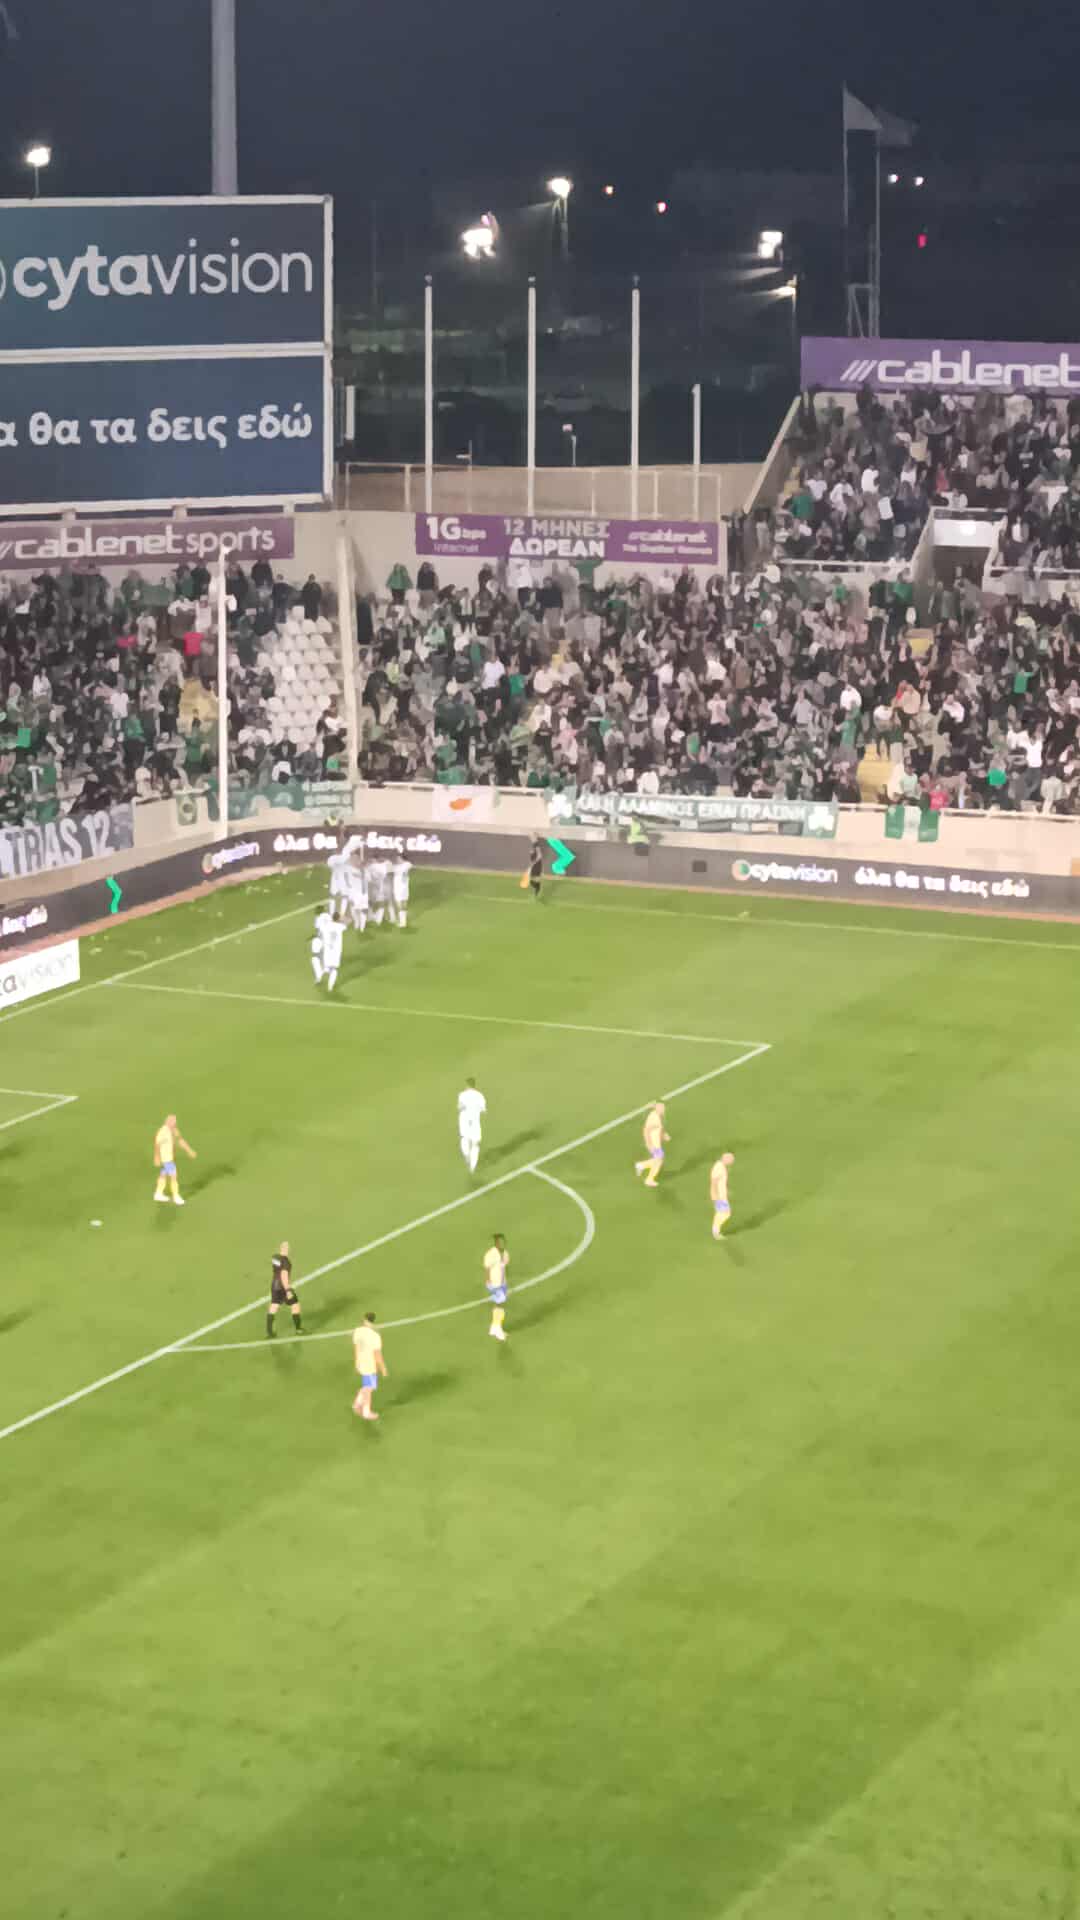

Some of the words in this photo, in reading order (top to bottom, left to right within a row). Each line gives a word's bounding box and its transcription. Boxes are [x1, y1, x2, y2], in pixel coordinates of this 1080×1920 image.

[13, 237, 313, 311] cytavision
[877, 350, 1080, 388] cablenet
[29, 411, 81, 446] θα
[90, 418, 137, 444] τα
[147, 407, 227, 449] δεις
[237, 402, 313, 440] εδώ
[503, 518, 526, 536] 12
[509, 537, 605, 558] ΔΩΡΕΑΝ
[81, 810, 115, 858] 12
